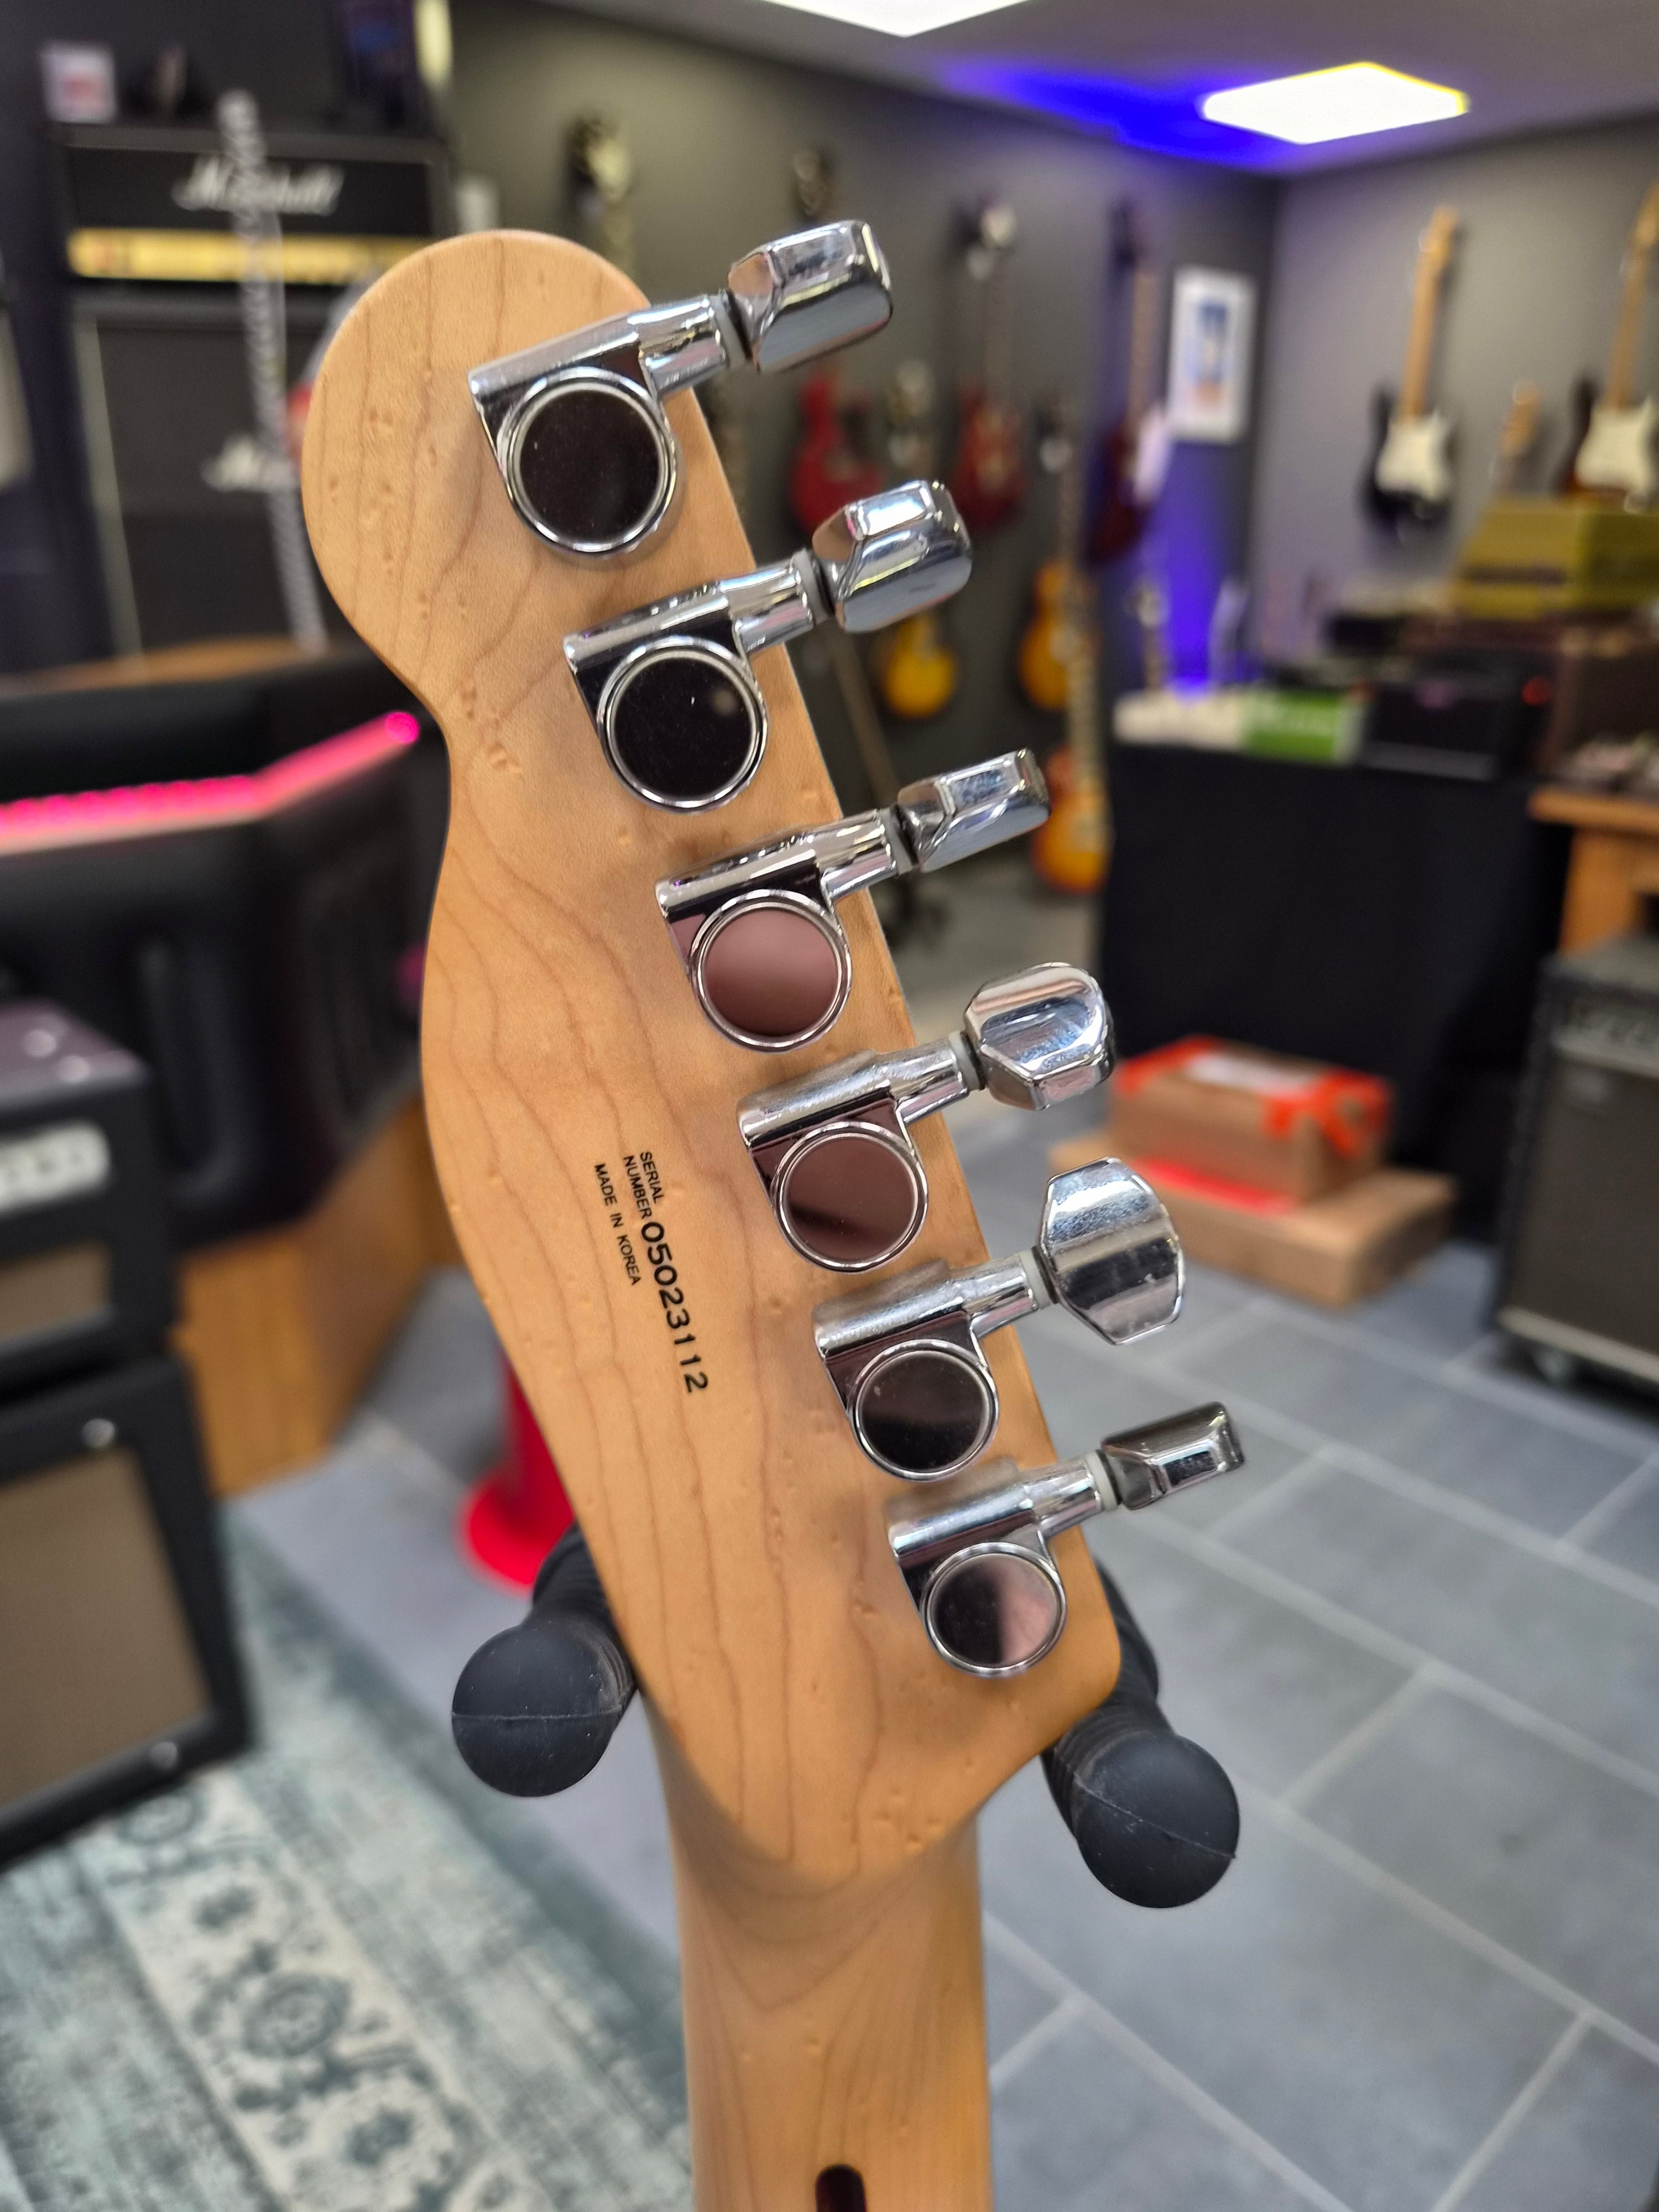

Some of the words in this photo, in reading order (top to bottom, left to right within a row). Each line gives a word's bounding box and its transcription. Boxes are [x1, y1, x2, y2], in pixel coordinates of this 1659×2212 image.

[594, 1163, 618, 1207] MADE
[610, 1212, 624, 1228] IN
[617, 1234, 642, 1286] KOREA
[640, 1151, 665, 1204] SERIAL
[623, 1155, 653, 1220] NUMBER
[641, 1221, 708, 1394] 05023112
